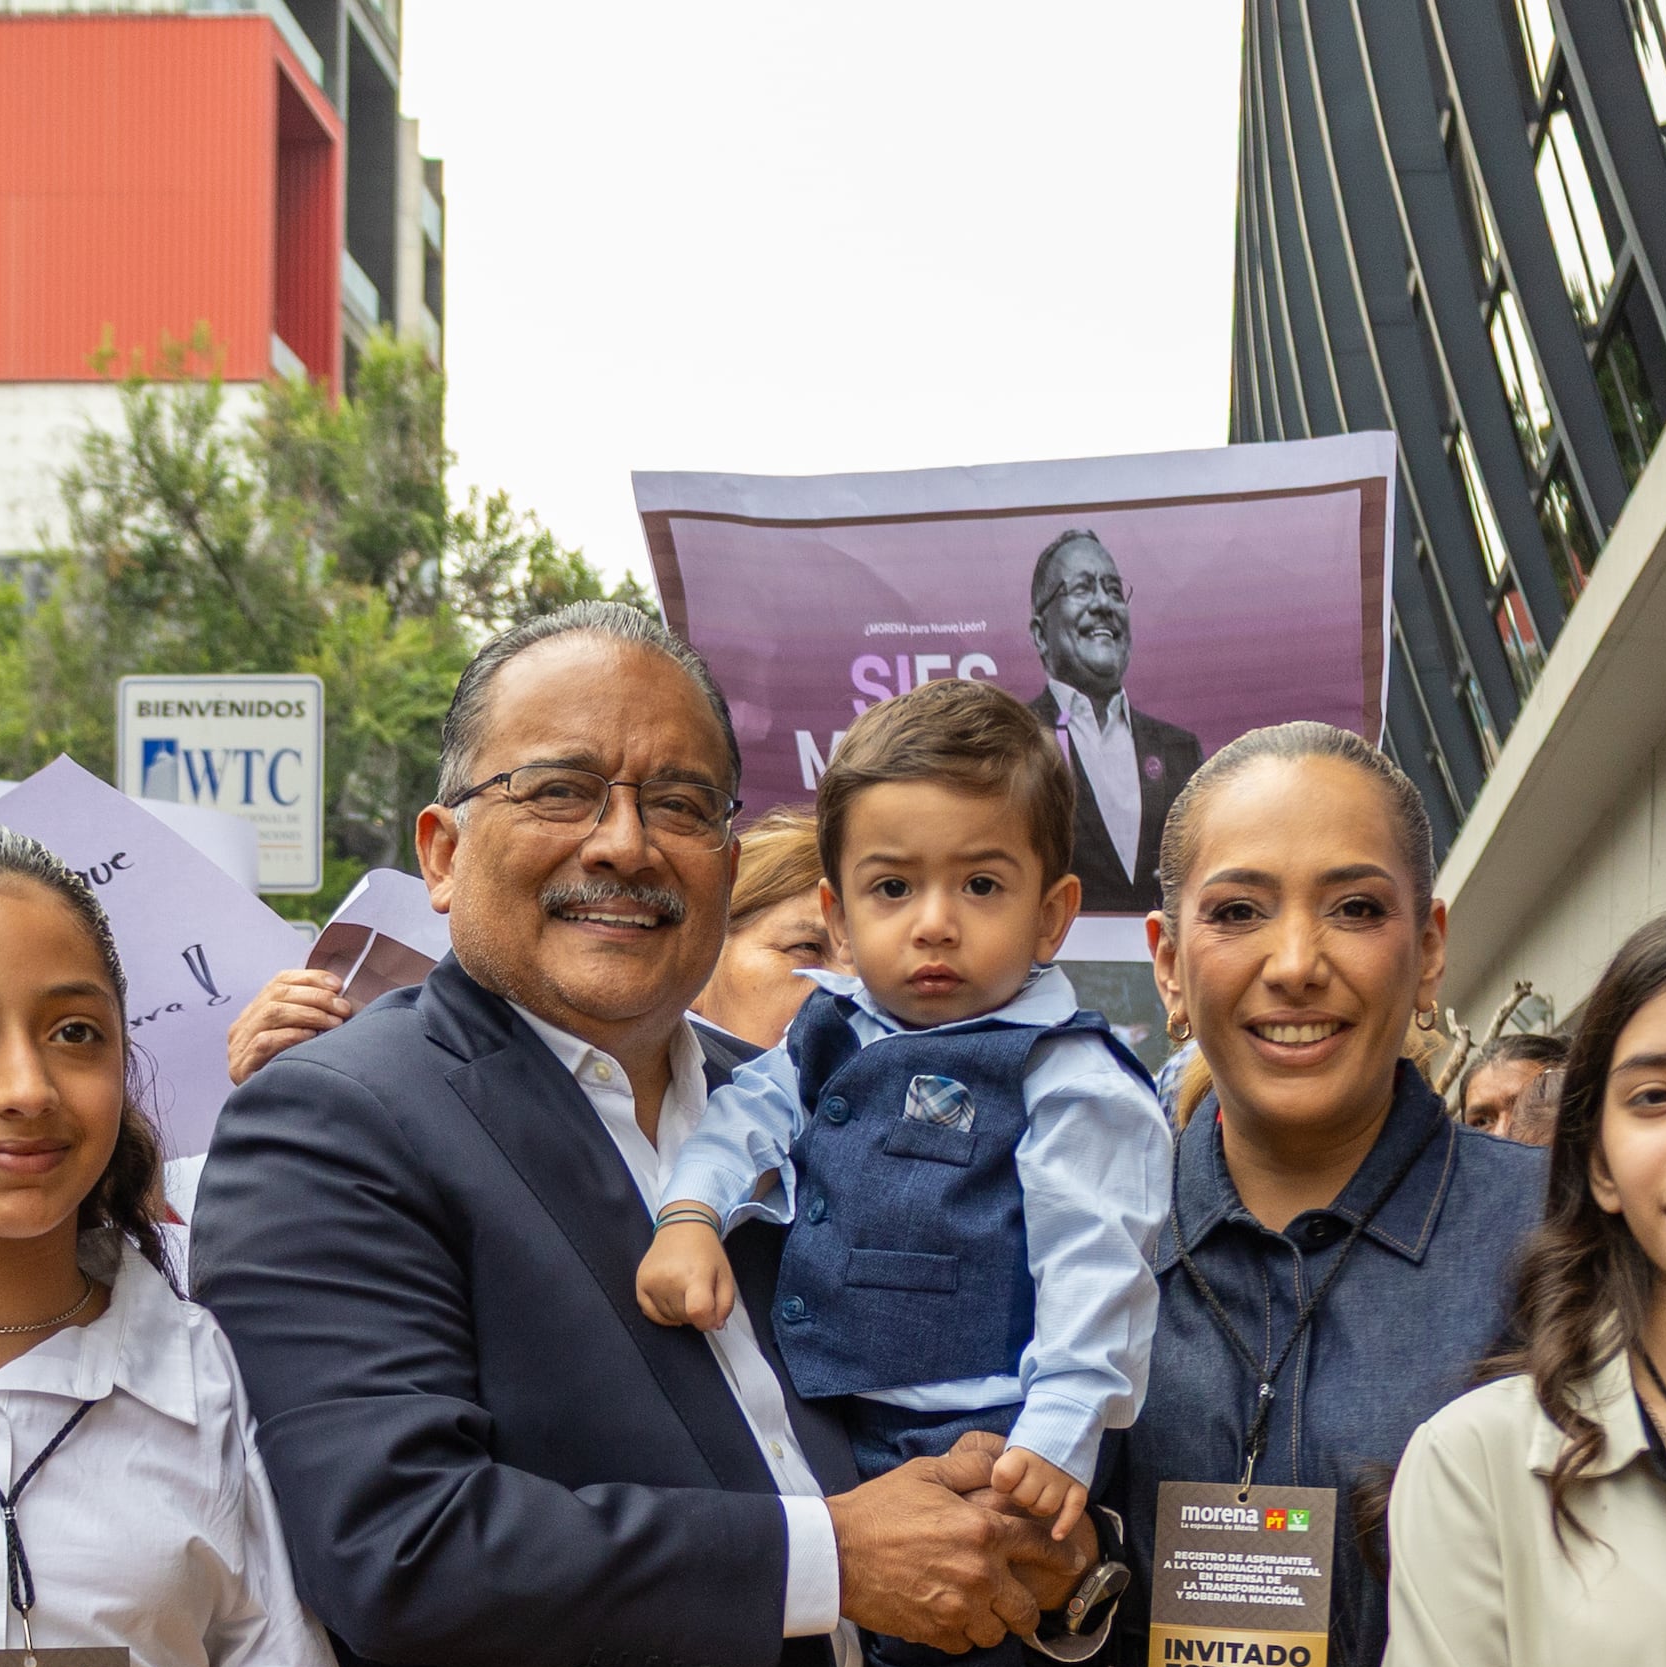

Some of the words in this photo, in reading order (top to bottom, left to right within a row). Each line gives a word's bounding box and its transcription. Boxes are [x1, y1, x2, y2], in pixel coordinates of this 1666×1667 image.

[909, 624, 930, 636] para
[930, 622, 959, 634] Nuevo
[137, 699, 306, 718] BIENVENIDOS
[181, 747, 303, 806] WTC
[1181, 1506, 1259, 1524] morena
[1266, 1517, 1284, 1529] PT
[1174, 1551, 1226, 1562] REGISTRO
[1228, 1554, 1243, 1563] DE
[1244, 1555, 1312, 1566] ASPIRANTES
[1163, 1560, 1172, 1569] A
[1174, 1561, 1188, 1570] LA
[1190, 1561, 1273, 1574] COORDINACIÓN
[1275, 1566, 1322, 1577] ESTATAL
[1199, 1572, 1213, 1581] EN
[1215, 1573, 1264, 1584] DEFENSA
[1266, 1576, 1282, 1585] DE
[1183, 1582, 1198, 1590] LA
[1199, 1582, 1300, 1595] TRANSFORMACIÓN
[1176, 1591, 1183, 1600] Y
[1185, 1591, 1247, 1603] SOBERANÍA
[1249, 1595, 1306, 1606] NACIONAL
[1164, 1638, 1311, 1667] INVITADO
